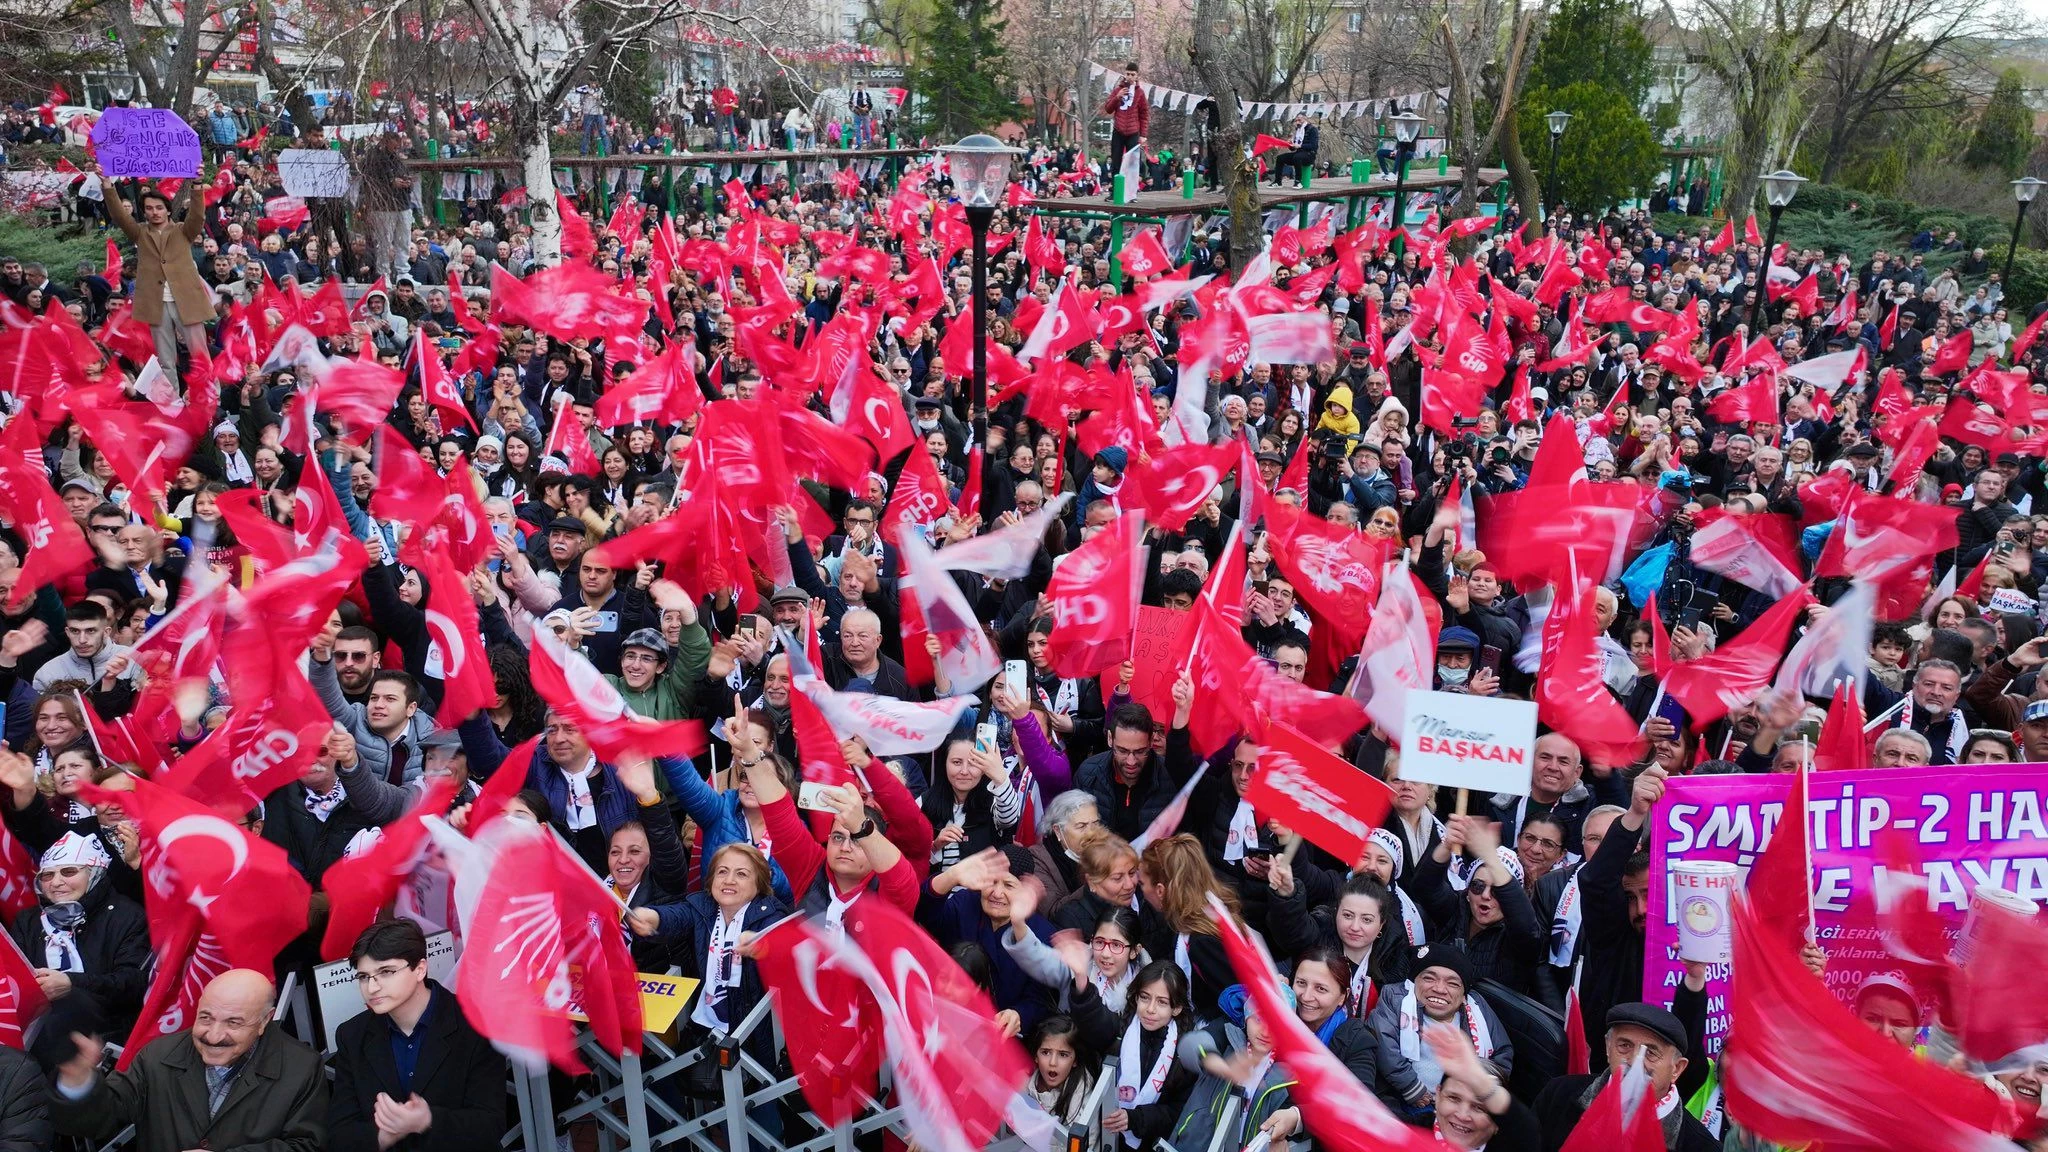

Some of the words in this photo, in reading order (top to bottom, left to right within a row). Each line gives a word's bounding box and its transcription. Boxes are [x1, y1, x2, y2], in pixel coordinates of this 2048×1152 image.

[1459, 352, 1488, 374] CHP
[1411, 713, 1496, 742] Mansur
[1418, 736, 1525, 765] BAŞKAN
[1808, 783, 1950, 850] TİP-2
[1968, 790, 2048, 840] HA
[428, 941, 442, 949] EK
[428, 946, 453, 958] KTIR
